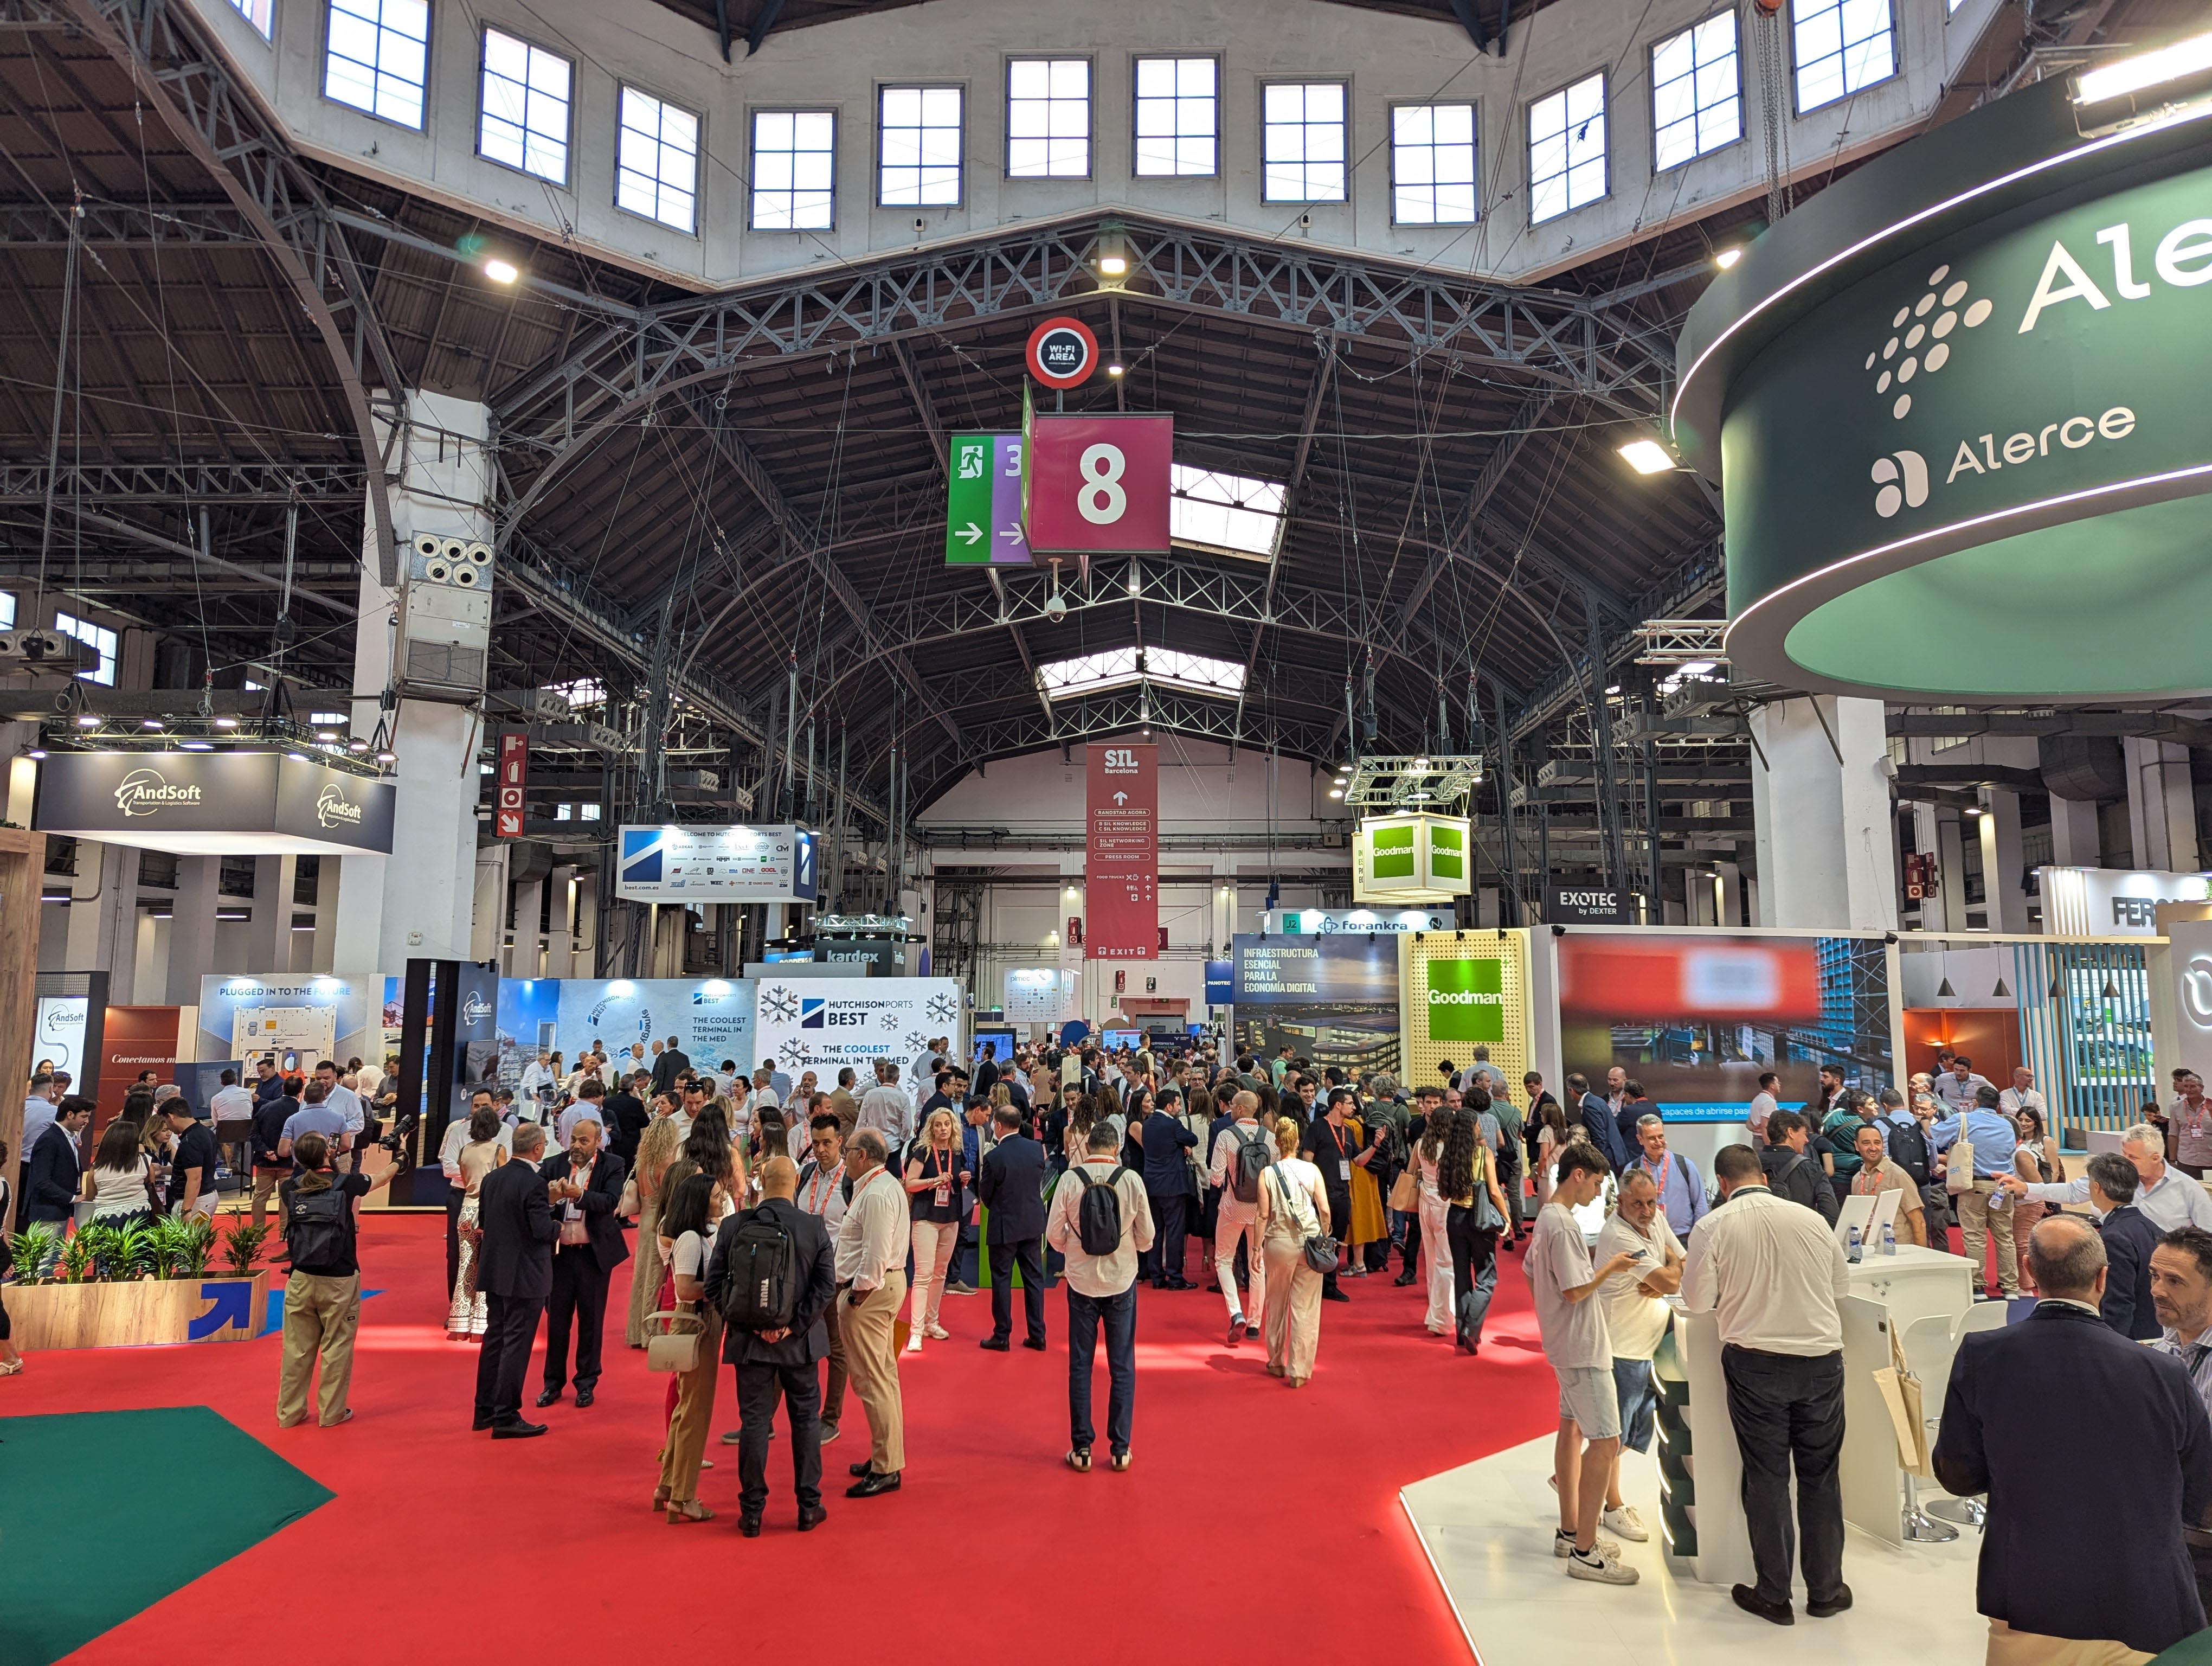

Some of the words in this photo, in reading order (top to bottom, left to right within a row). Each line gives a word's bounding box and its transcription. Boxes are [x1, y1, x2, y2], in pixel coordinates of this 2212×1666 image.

[1049, 353, 1075, 361] AREA
[1946, 406, 2135, 484] Alerce
[1005, 445, 1021, 477] 3
[1077, 443, 1127, 524] 8
[1105, 749, 1138, 767] SIL
[133, 785, 201, 799] AndSoft
[327, 799, 361, 819] AndSoft
[1373, 846, 1414, 857] Goodman
[1431, 845, 1462, 857] Goodman
[1560, 892, 1617, 906] EXOTEC
[1287, 920, 1297, 928] J2
[1342, 921, 1407, 930] forankra
[827, 950, 879, 962] kardex
[1244, 948, 1319, 958] INFRAESTRUCTURA
[1244, 960, 1282, 970] ESENCIAL
[1245, 971, 1265, 981] PARA
[1266, 971, 1277, 981] LA
[1245, 981, 1285, 992] ECONOMÍA
[1287, 983, 1317, 992] DIGITAL
[1428, 989, 1503, 1004] Goodman
[470, 1003, 491, 1013] AndSoft
[591, 996, 636, 1015] HUTCHISONORTS
[595, 1004, 607, 1018] BEST
[829, 1001, 913, 1009] HUTCHISONPORTS
[56, 1013, 83, 1022] AndSoft
[828, 1013, 868, 1025] BEST
[844, 1045, 890, 1053] COOLEST
[112, 1054, 165, 1063] Conectamos
[760, 1278, 769, 1308] THULE
